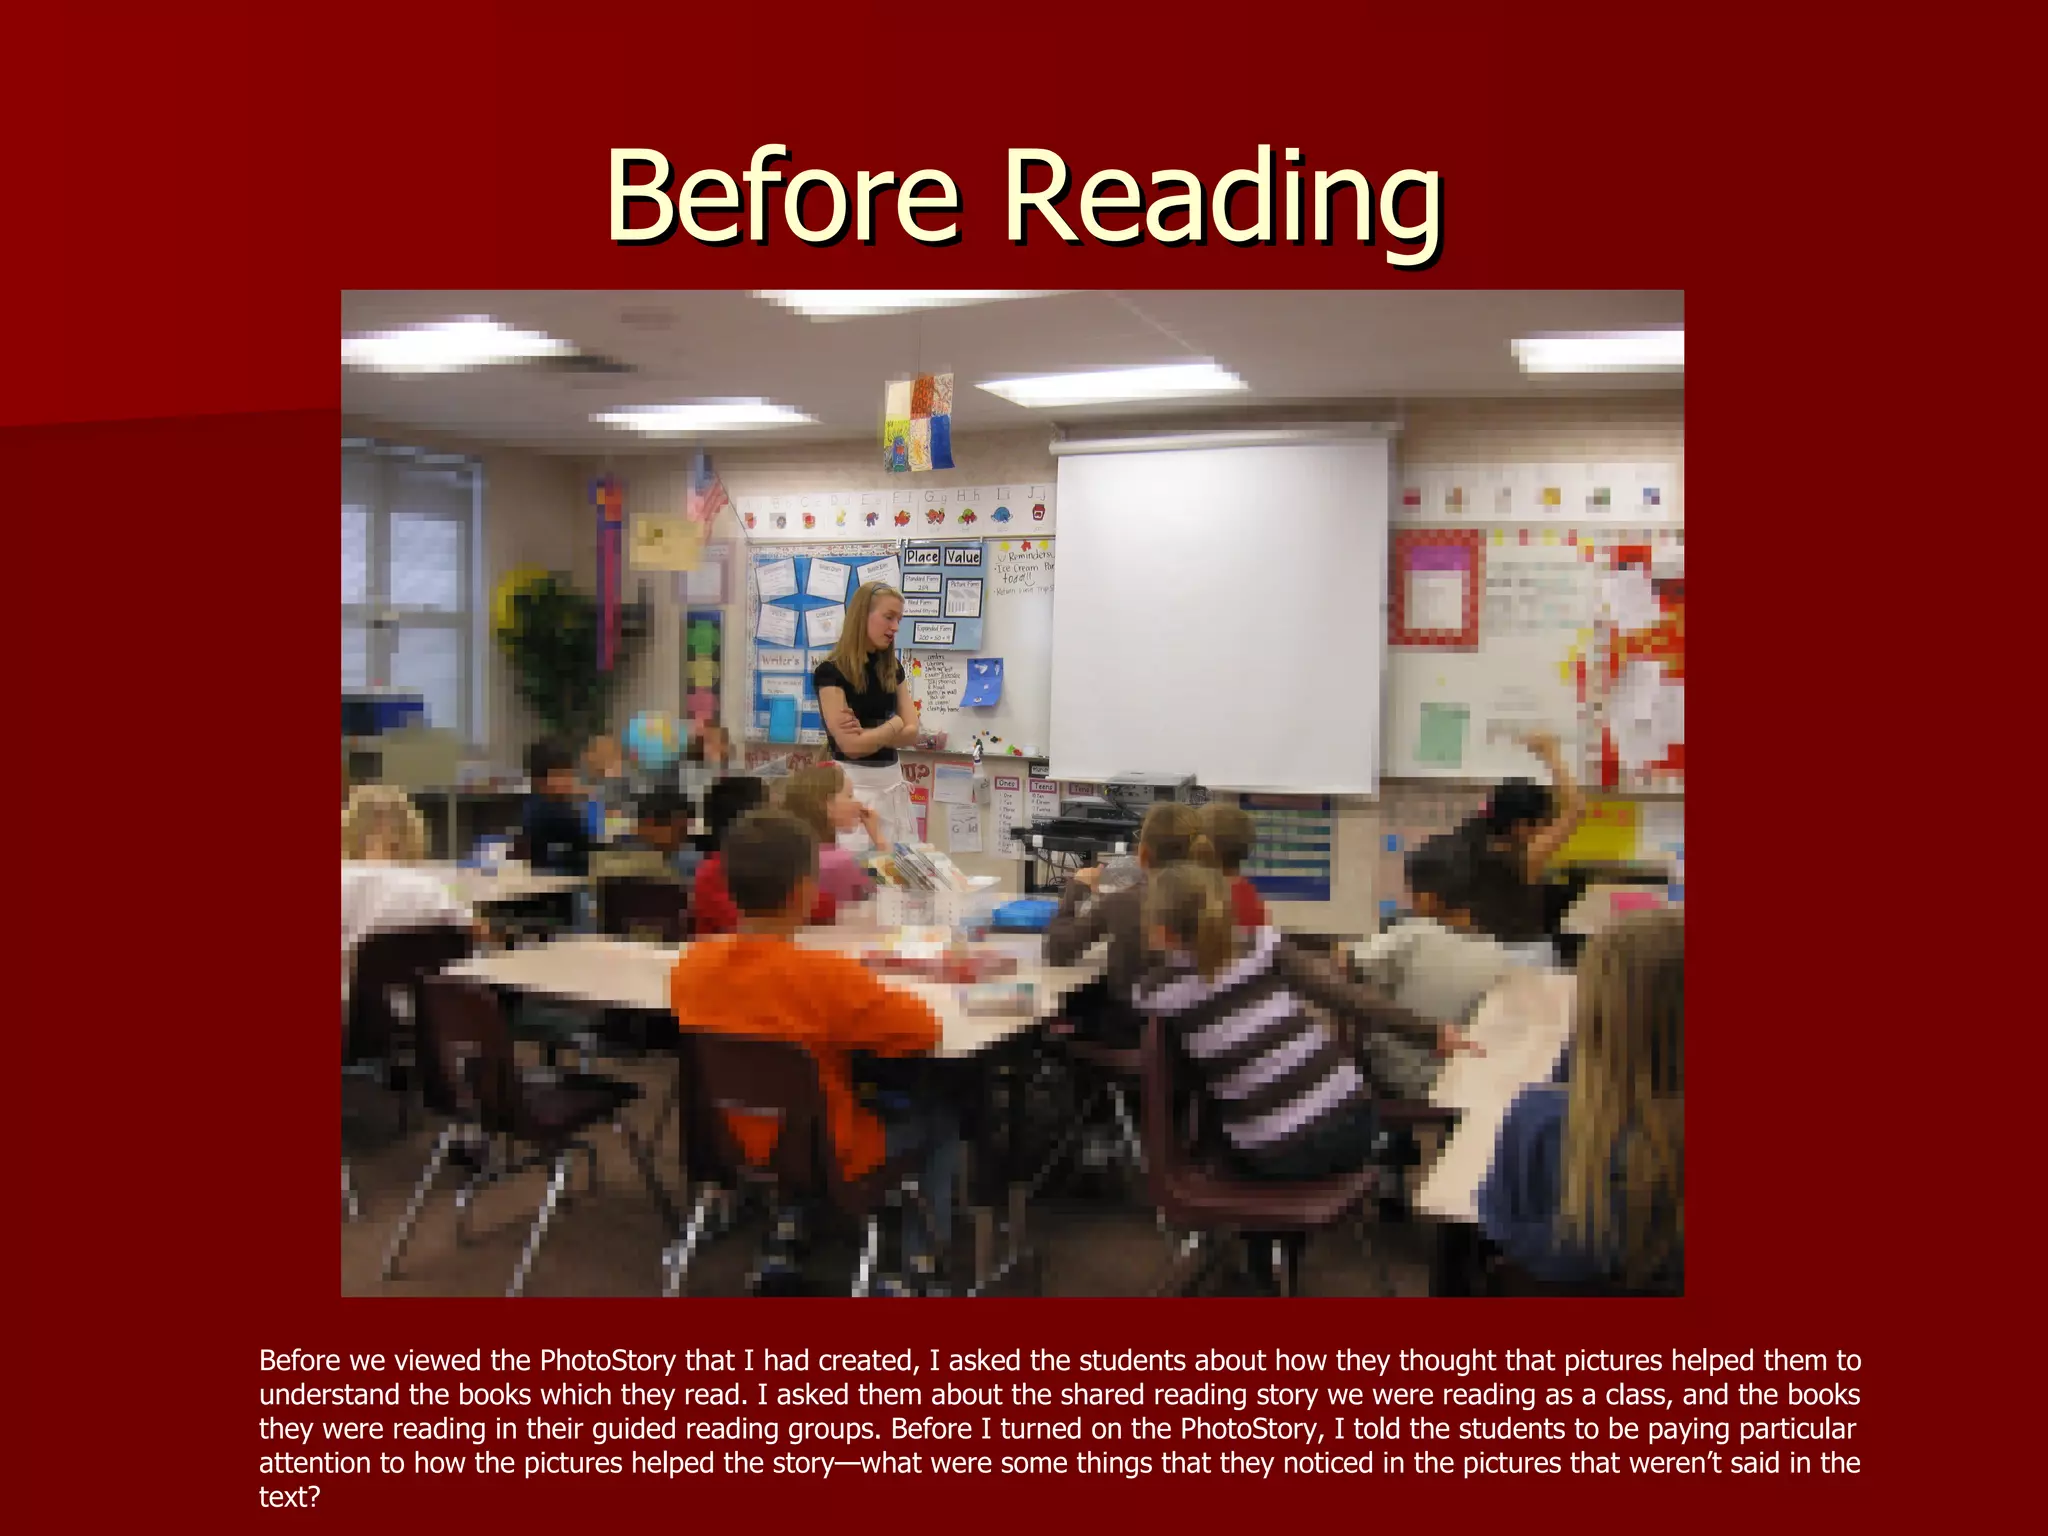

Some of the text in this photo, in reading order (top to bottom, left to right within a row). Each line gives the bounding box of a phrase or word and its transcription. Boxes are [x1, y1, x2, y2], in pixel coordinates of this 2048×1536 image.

[907, 549, 980, 563] Place Value
[997, 561, 1055, 574] Ice Cream Par
[999, 779, 1015, 787] Ones
